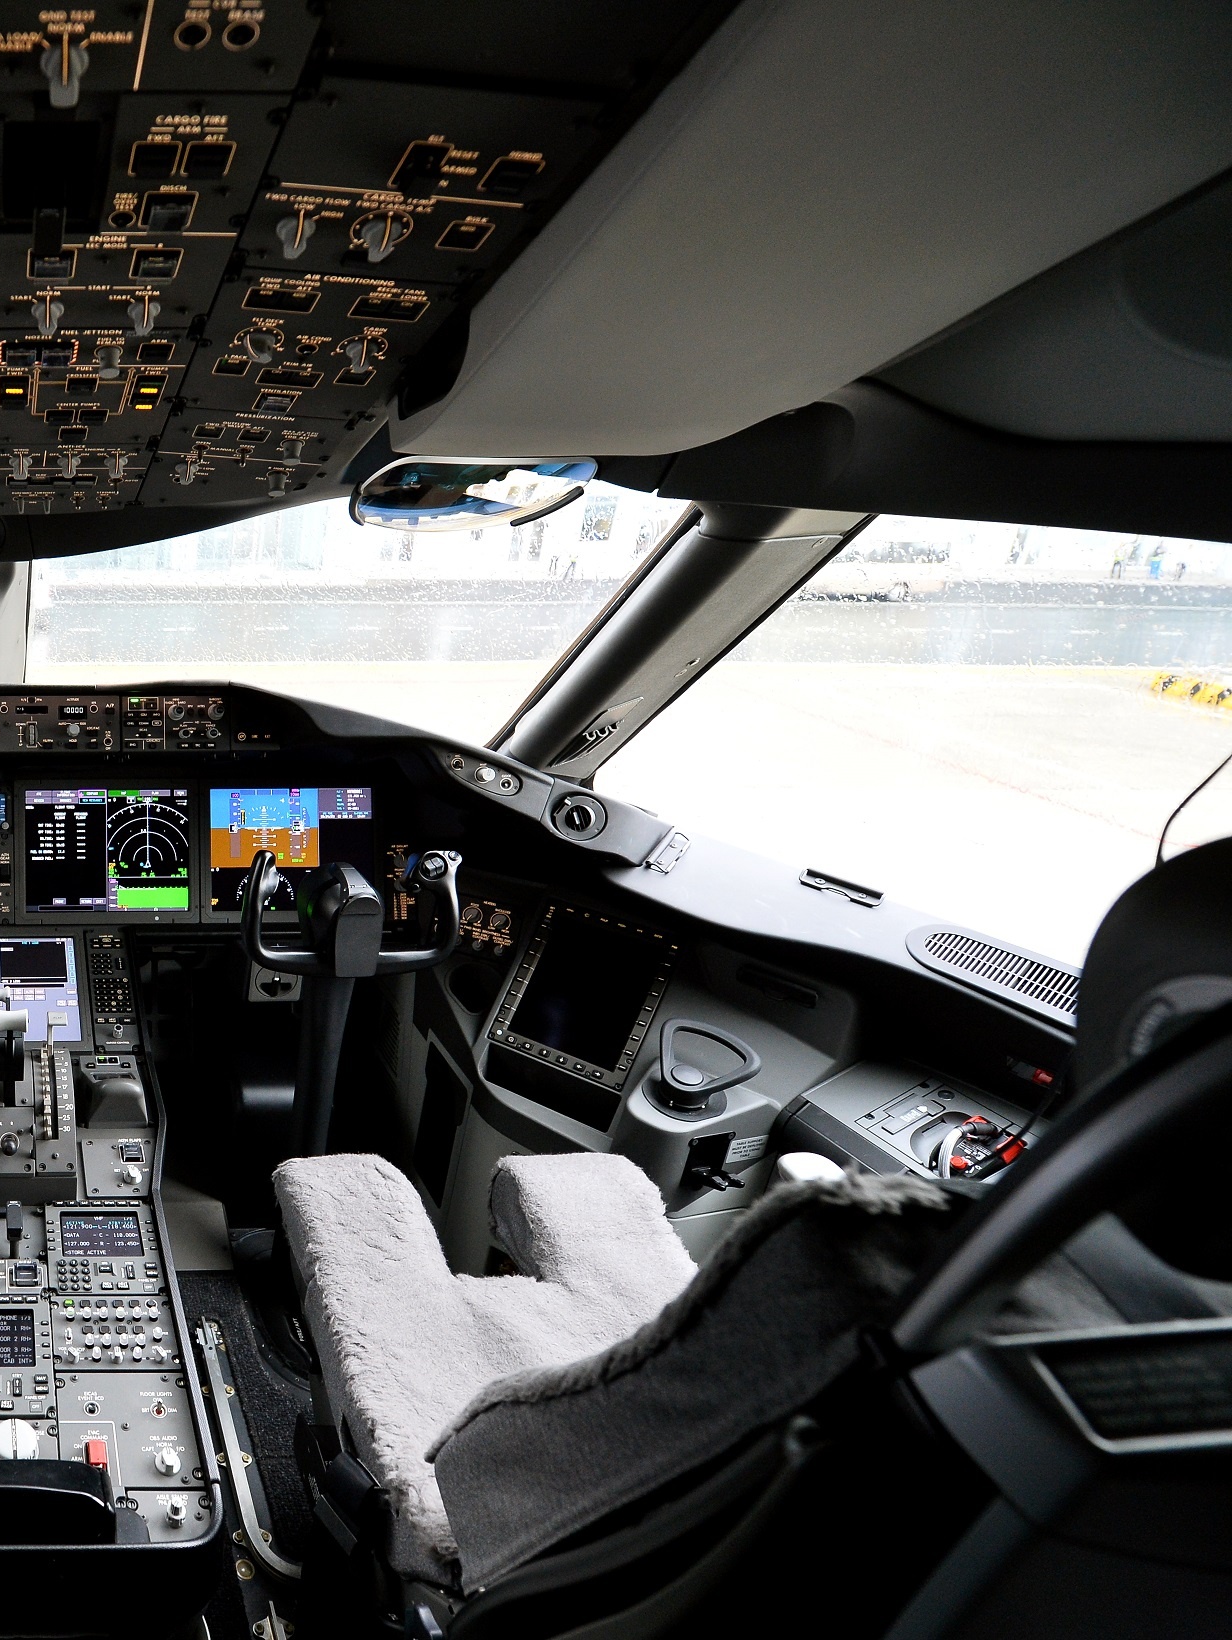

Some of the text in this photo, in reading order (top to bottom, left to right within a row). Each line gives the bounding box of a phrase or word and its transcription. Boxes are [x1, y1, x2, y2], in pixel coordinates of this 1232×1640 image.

[156, 115, 228, 125] CARGO FIRE
[177, 126, 201, 134] ARM
[147, 134, 172, 143] FWD
[290, 194, 324, 204] CARGO
[325, 198, 352, 206] FLOW
[320, 210, 344, 219] HIGH
[284, 279, 320, 287] COOLING
[323, 275, 396, 287] CONDITIONING
[236, 413, 295, 421] PRESSURIZATION
